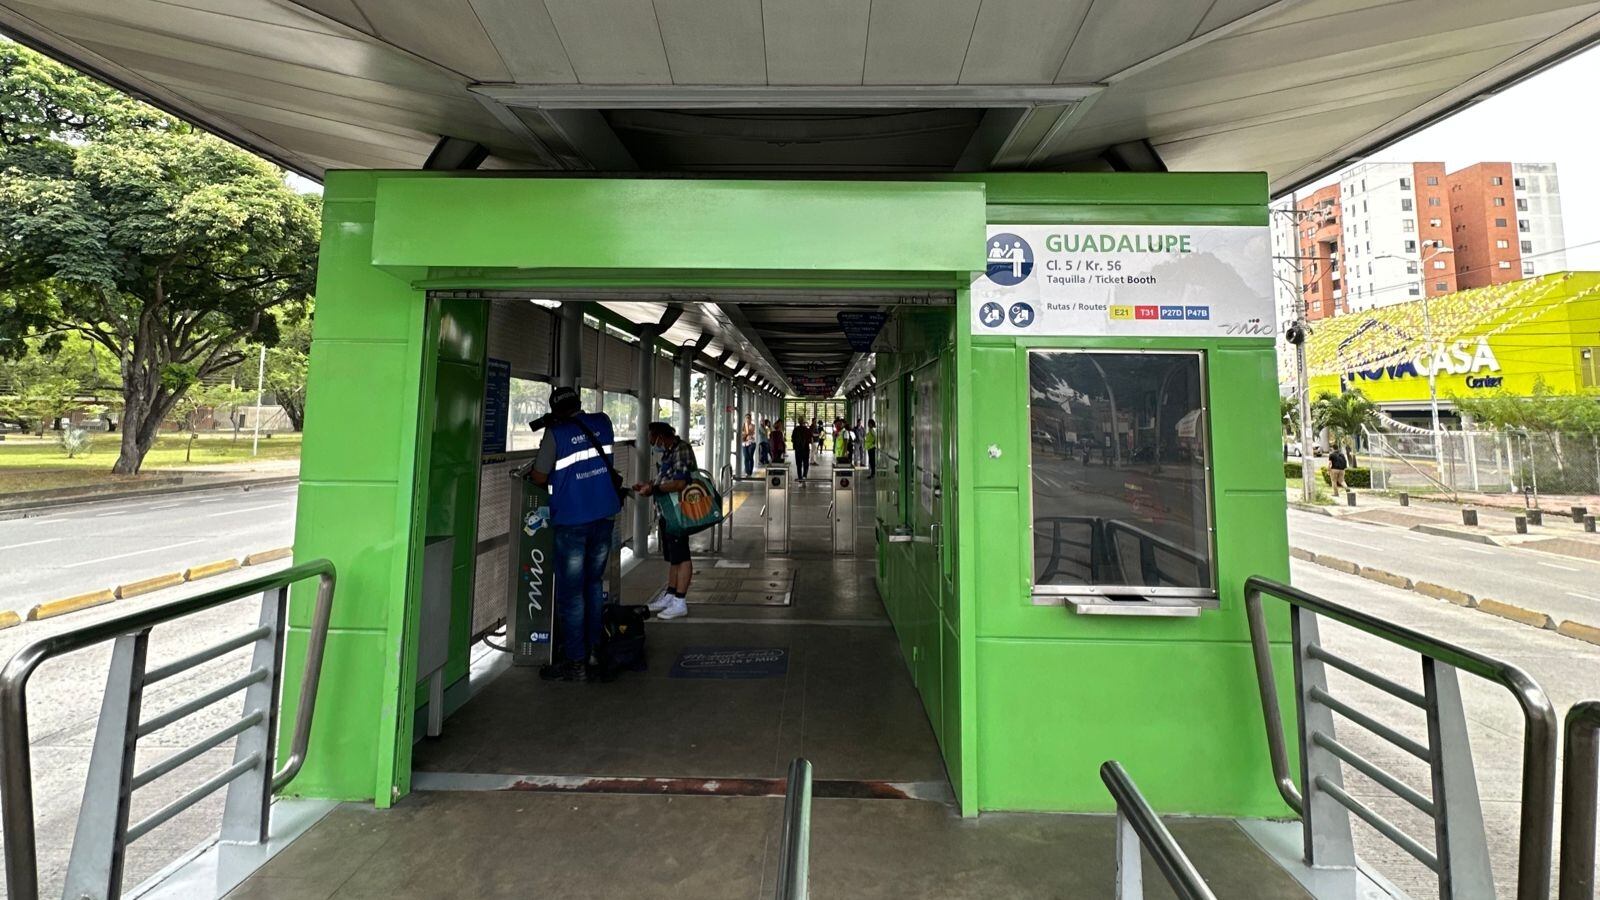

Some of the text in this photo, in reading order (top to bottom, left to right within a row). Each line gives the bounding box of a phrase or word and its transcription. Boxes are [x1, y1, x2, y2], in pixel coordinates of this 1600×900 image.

[1045, 234, 1191, 253] GUADALUPE
[1046, 260, 1061, 271] Cl.
[1065, 260, 1073, 271] 5
[1085, 260, 1103, 271] Kr.
[1107, 260, 1122, 271] 56
[1047, 275, 1086, 286] Taquilla
[1095, 275, 1124, 284] Ticket
[1127, 275, 1157, 284] Booth
[1047, 303, 1071, 311] Rutas
[1078, 303, 1108, 311] Routes
[1114, 308, 1130, 317] E21
[1140, 309, 1155, 317] T31
[1161, 309, 1182, 317] P27D
[1187, 310, 1208, 318] P47B
[1466, 375, 1503, 388] Center
